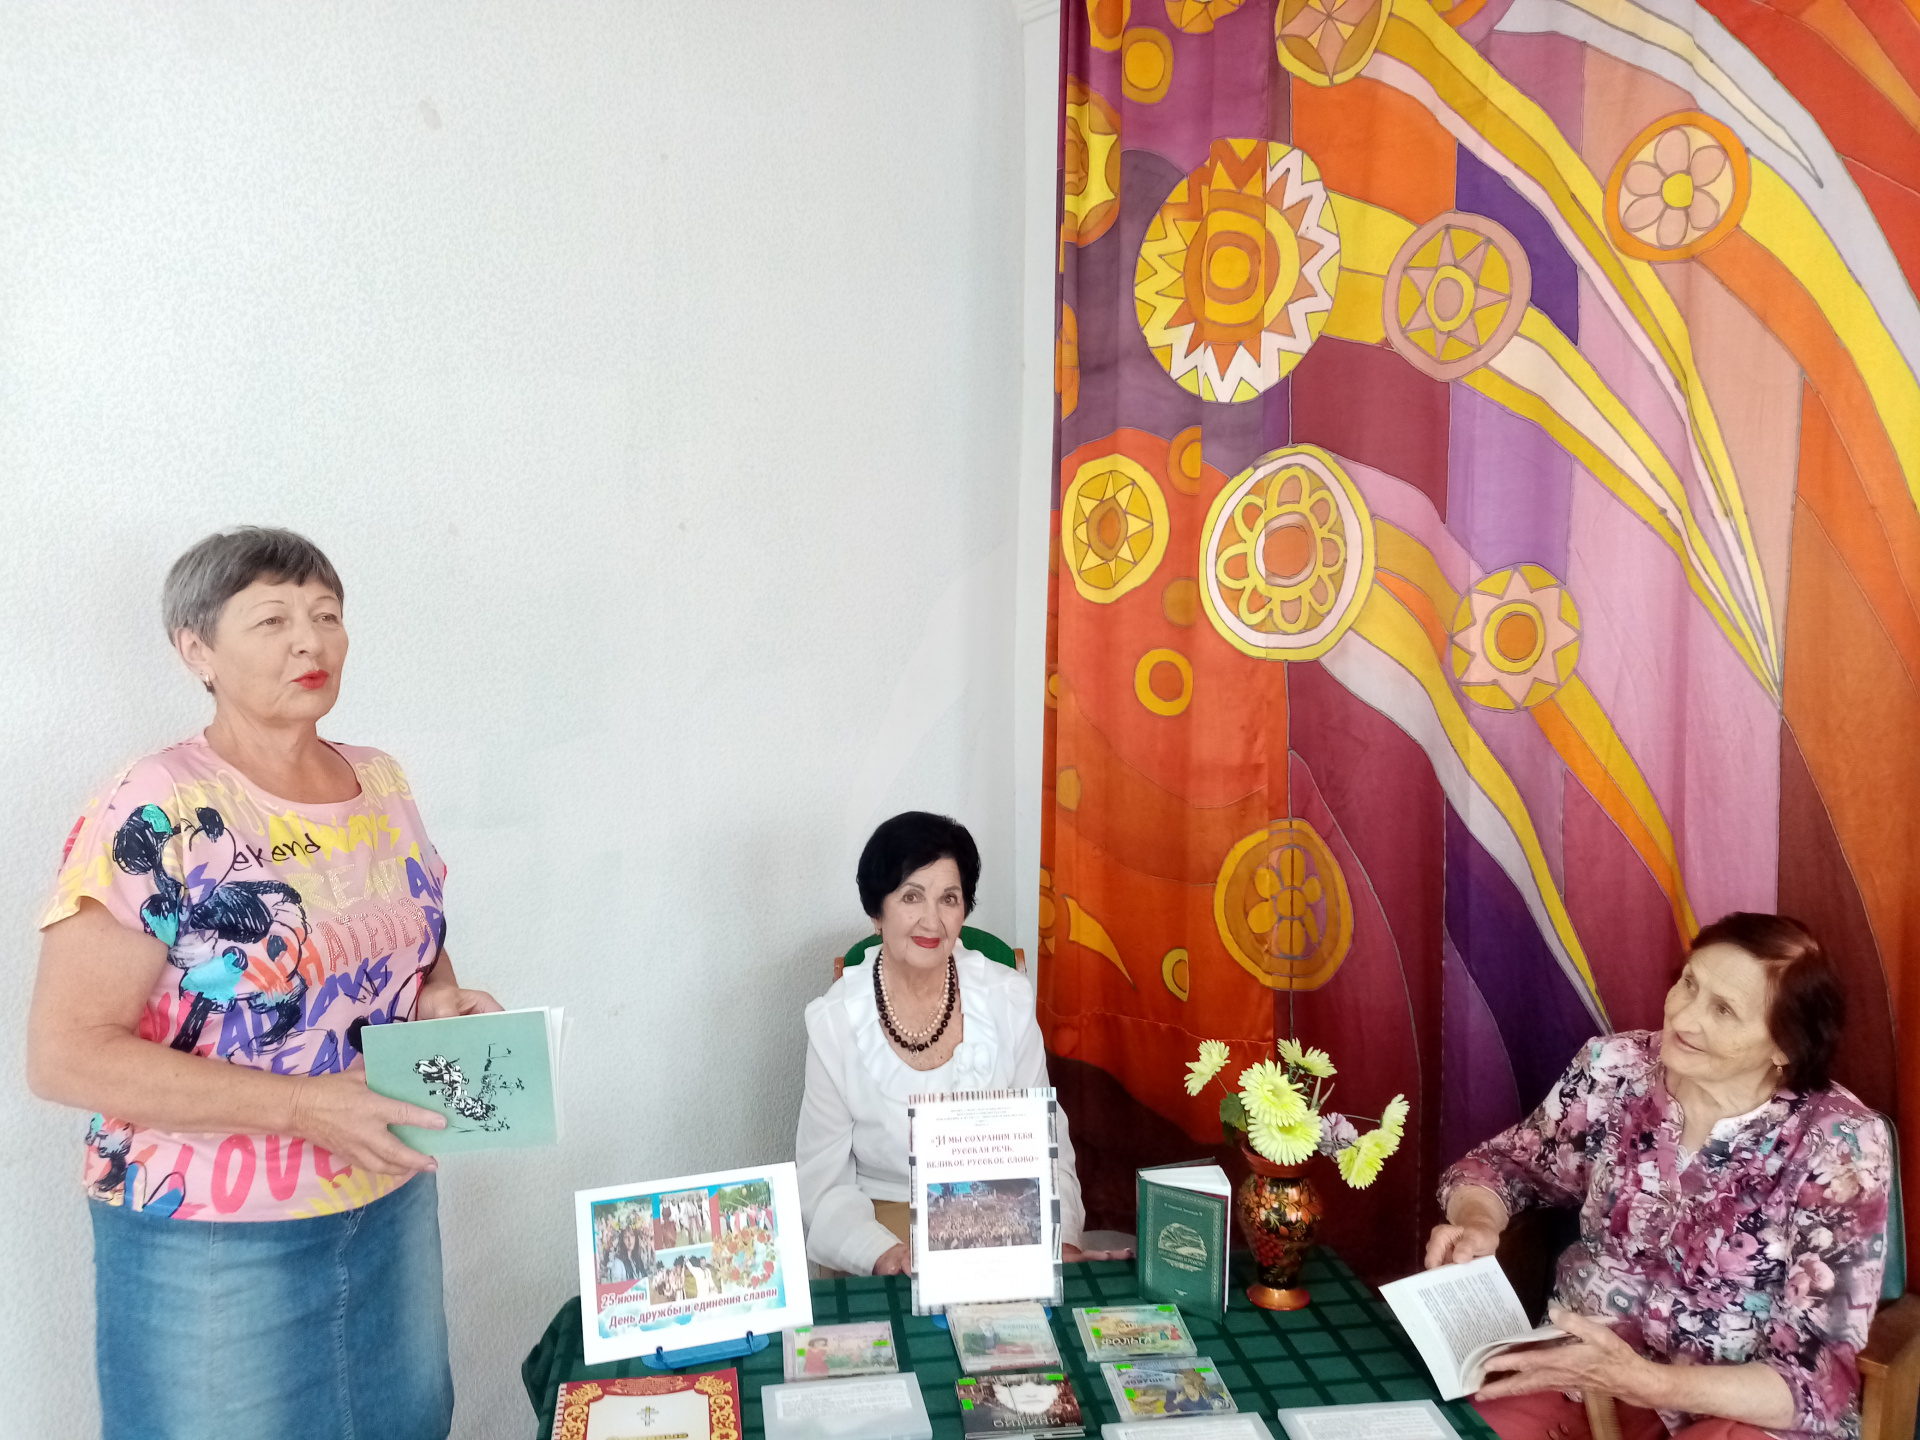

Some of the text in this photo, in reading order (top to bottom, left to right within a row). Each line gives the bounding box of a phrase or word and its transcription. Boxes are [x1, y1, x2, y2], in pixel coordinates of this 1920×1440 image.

[951, 1147, 990, 1156] РУССКАЯ
[926, 1160, 965, 1169] ВЕЛИКОЕ
[967, 1157, 1005, 1166] РУССКОЕ
[601, 1292, 645, 1307] 25 июня
[609, 1288, 778, 1330] День дружбы и единения славян
